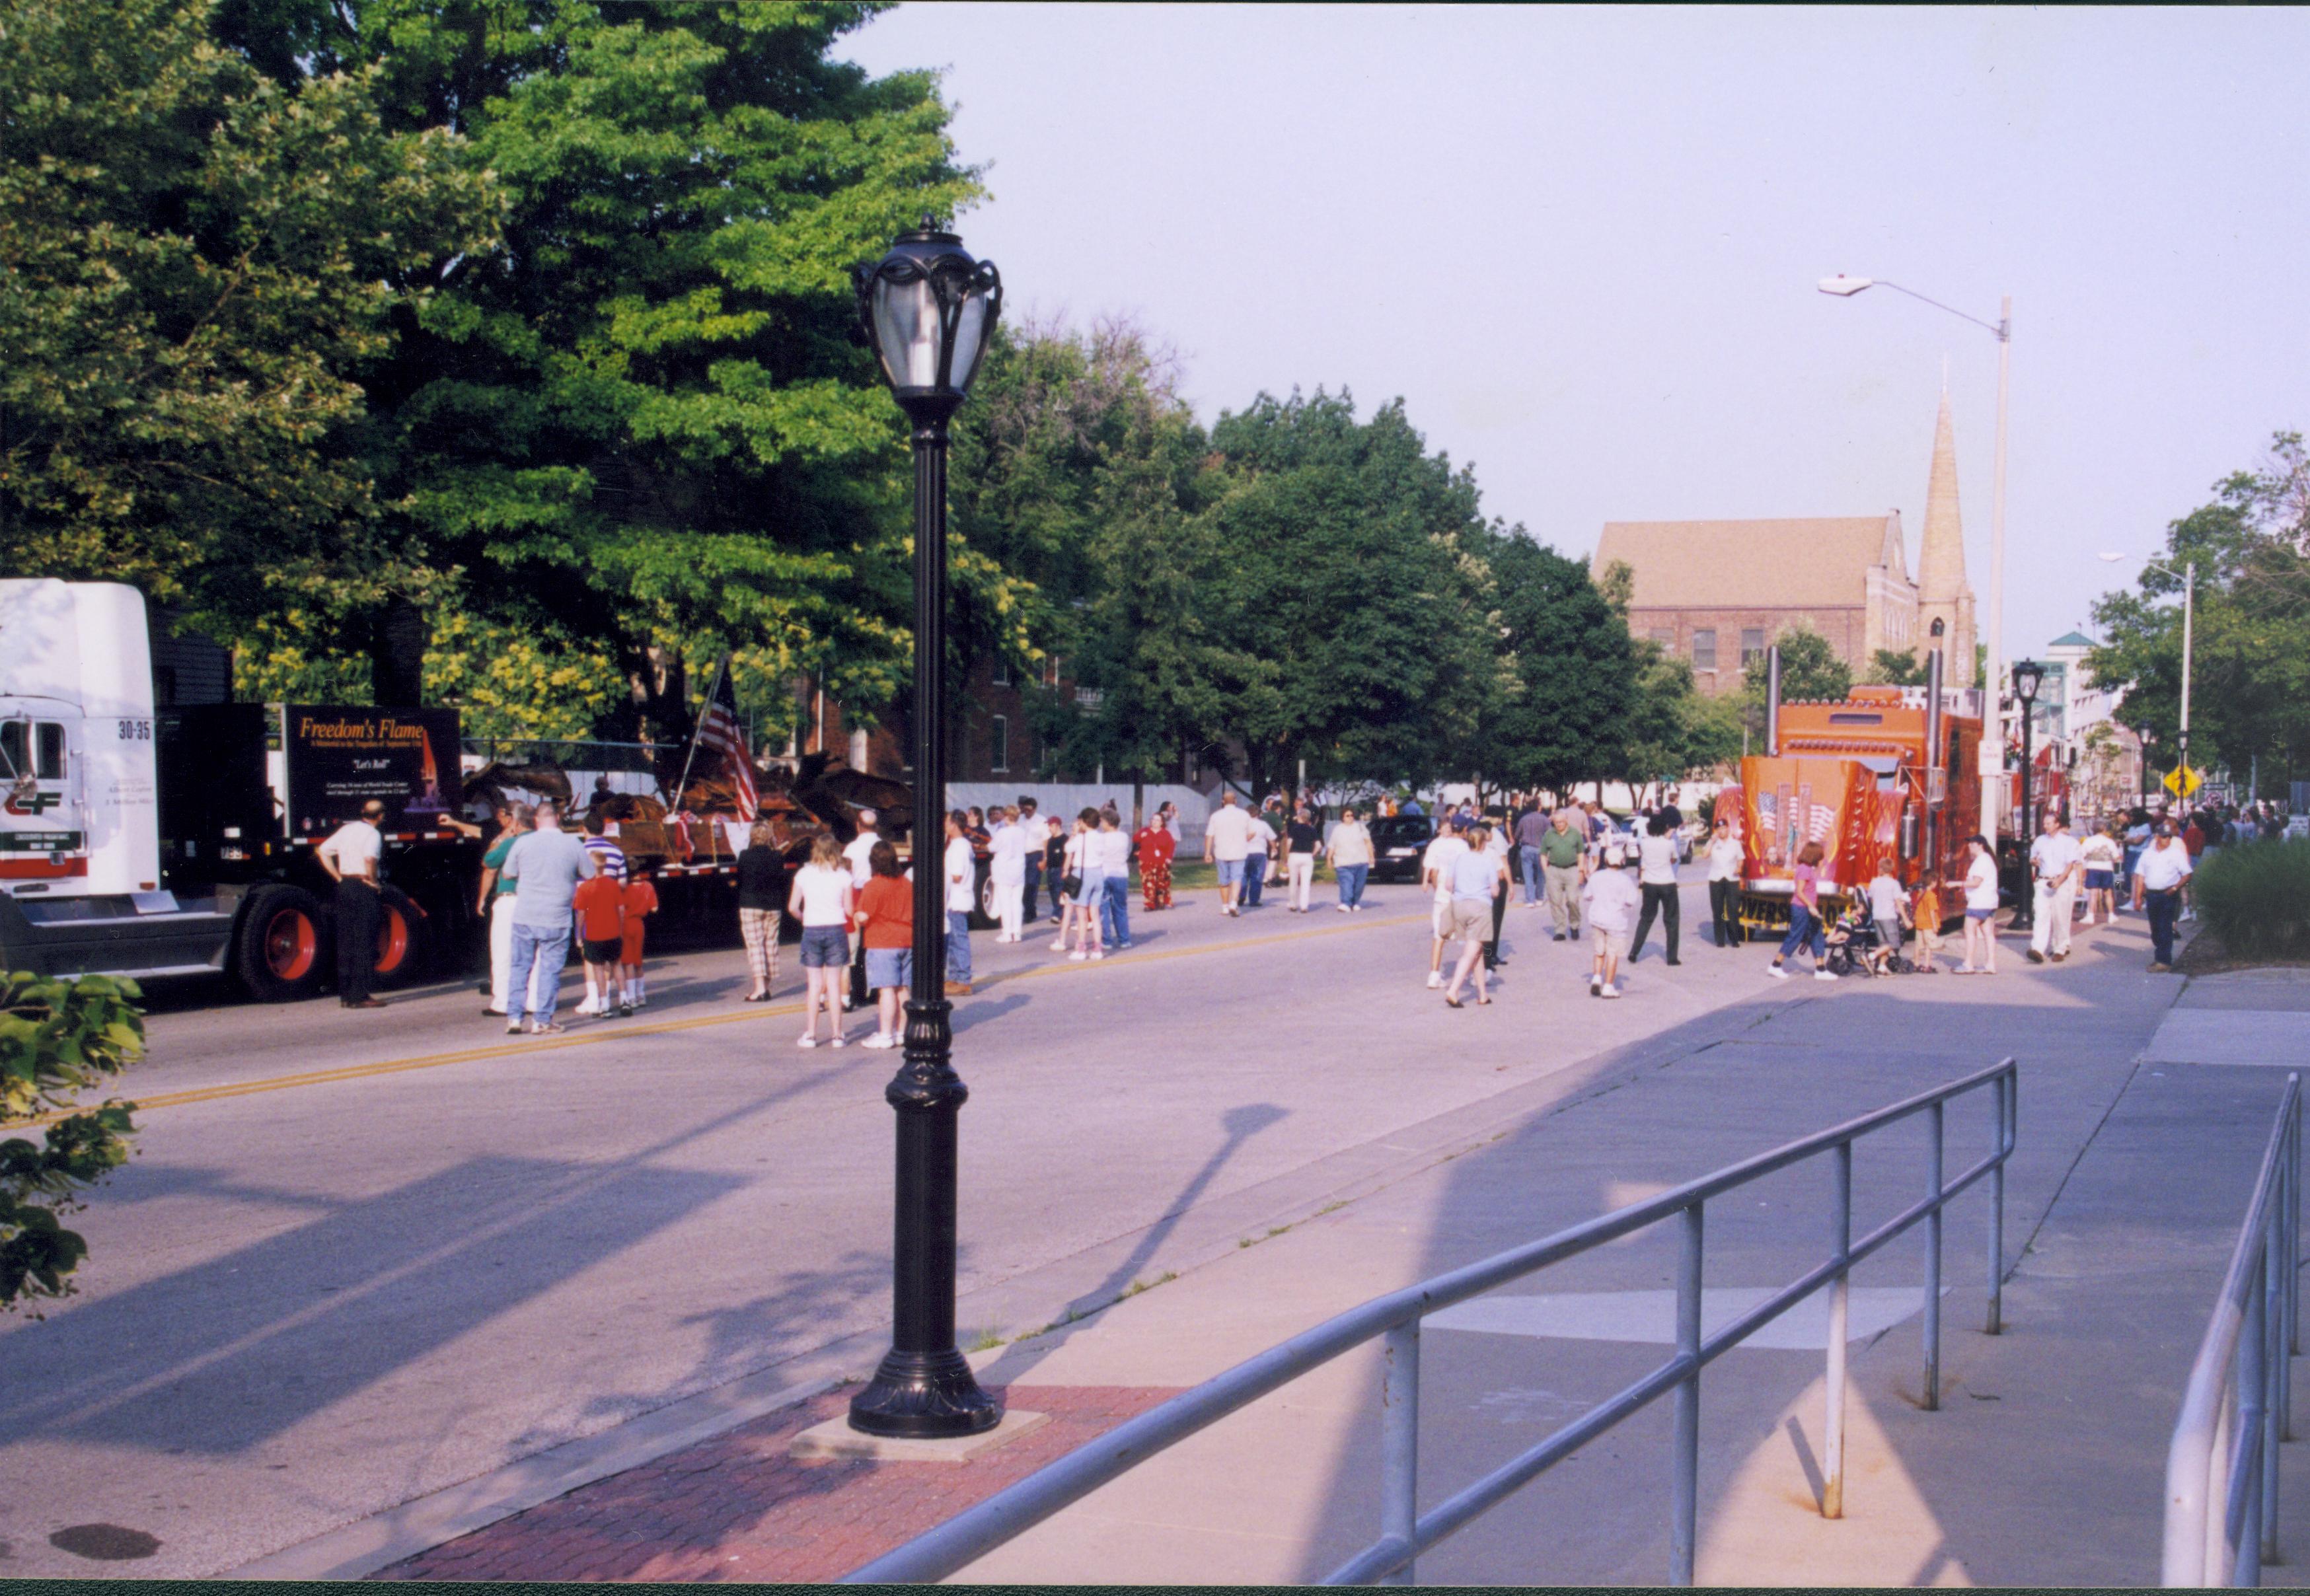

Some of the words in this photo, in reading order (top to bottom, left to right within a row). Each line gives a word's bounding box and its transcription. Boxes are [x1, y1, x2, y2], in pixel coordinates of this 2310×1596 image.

[119, 721, 150, 740] 30-35
[300, 717, 375, 739] Freedom's
[378, 719, 424, 739] Flame
[5, 793, 62, 815] CF
[1736, 897, 1791, 924] OVERS
